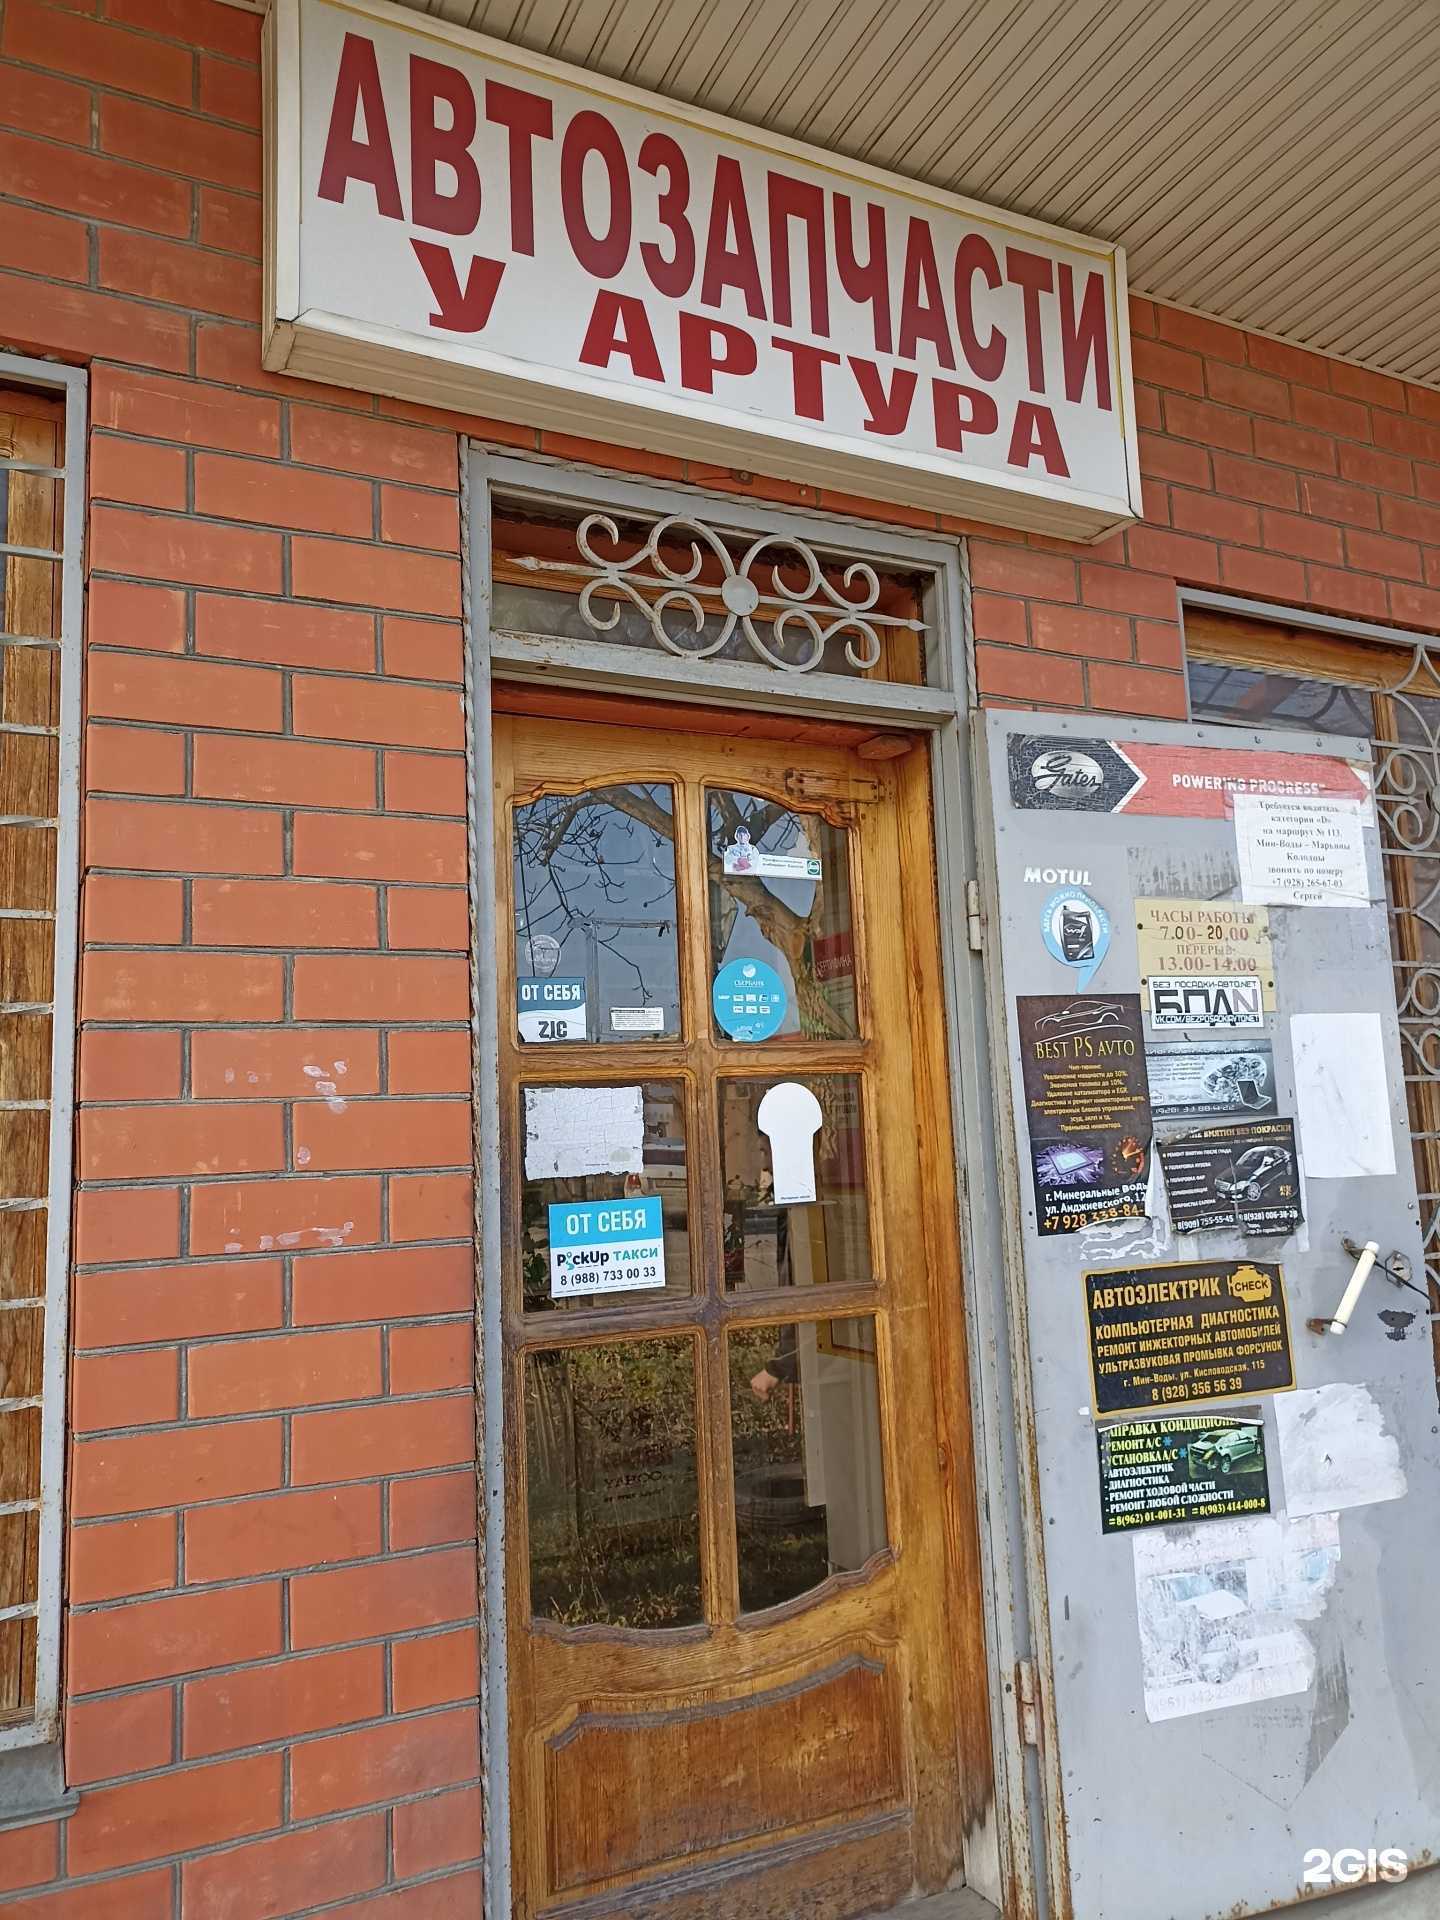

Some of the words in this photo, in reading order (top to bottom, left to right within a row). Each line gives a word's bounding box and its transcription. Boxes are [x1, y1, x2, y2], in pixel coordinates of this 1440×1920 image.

[317, 32, 1112, 411] АВТОЗАПЧАСТИ
[409, 237, 506, 333] У
[578, 288, 1070, 478] АРТУРА
[1034, 753, 1101, 790] Gates
[1172, 773, 1246, 792] POWERING
[1023, 867, 1092, 886] MOTUL
[1150, 910, 1193, 923] ЧАСЫ
[1198, 911, 1255, 925] РАБОТЫ
[1159, 957, 1257, 971] 13.00-14.00
[521, 984, 540, 1001] ОТ
[543, 984, 581, 1001] СЕБЯ
[1035, 1041, 1069, 1059] BEST
[1073, 1036, 1093, 1057] PS
[1251, 1123, 1292, 1135] ПОКРАСКИ
[1053, 1187, 1120, 1201] Минеральные
[1045, 1206, 1059, 1216] ул.
[566, 1213, 592, 1235] ОТ
[597, 1209, 647, 1233] СЕБЯ
[1043, 1215, 1059, 1230] +7
[1062, 1214, 1087, 1229] 928
[612, 1247, 658, 1261] ТАКСИ
[560, 1275, 567, 1286] 8
[570, 1272, 599, 1287] (988)
[603, 1269, 623, 1281] 733
[626, 1268, 640, 1279] 00
[643, 1266, 656, 1277] 33
[1234, 1279, 1269, 1292] CHECK
[1093, 1276, 1221, 1310] АВТОЭЛЕКТРИК
[1095, 1315, 1194, 1341] КОМПЬЮТЕРНАЯ
[1201, 1305, 1280, 1329] ДИАГНОСТИКА
[1097, 1341, 1137, 1358] РЕМОНТ
[1139, 1331, 1213, 1352] ИНЖЕКТОРНЫХ
[1214, 1322, 1281, 1342] АВТОМОБИЛЕЙ
[1098, 1352, 1181, 1375] УЛЬТРАЗВУКОВАЯ
[1183, 1346, 1234, 1366] ПРОМЫВКА
[1236, 1339, 1283, 1356] ФОРСУНОК
[1180, 1371, 1191, 1382] ул.
[1251, 1360, 1265, 1370] 115
[1151, 1388, 1159, 1401] 8
[1161, 1384, 1190, 1402] (928)
[1191, 1381, 1211, 1396] 356
[1213, 1379, 1226, 1392] 56
[1228, 1376, 1243, 1391] 39
[1105, 1439, 1145, 1452] РЕМОНТ
[1106, 1451, 1162, 1467] УСТАНОВКА
[1146, 1483, 1188, 1498] ХОДОВОЙ
[1188, 1480, 1216, 1492] ЧАСТИ
[1147, 1495, 1180, 1509] ЛЮБОЙ
[1180, 1490, 1234, 1506] СЛОЖНОСТИ
[1144, 1508, 1186, 1522] 01-001-31
[1226, 1498, 1266, 1511] 414-000-8
